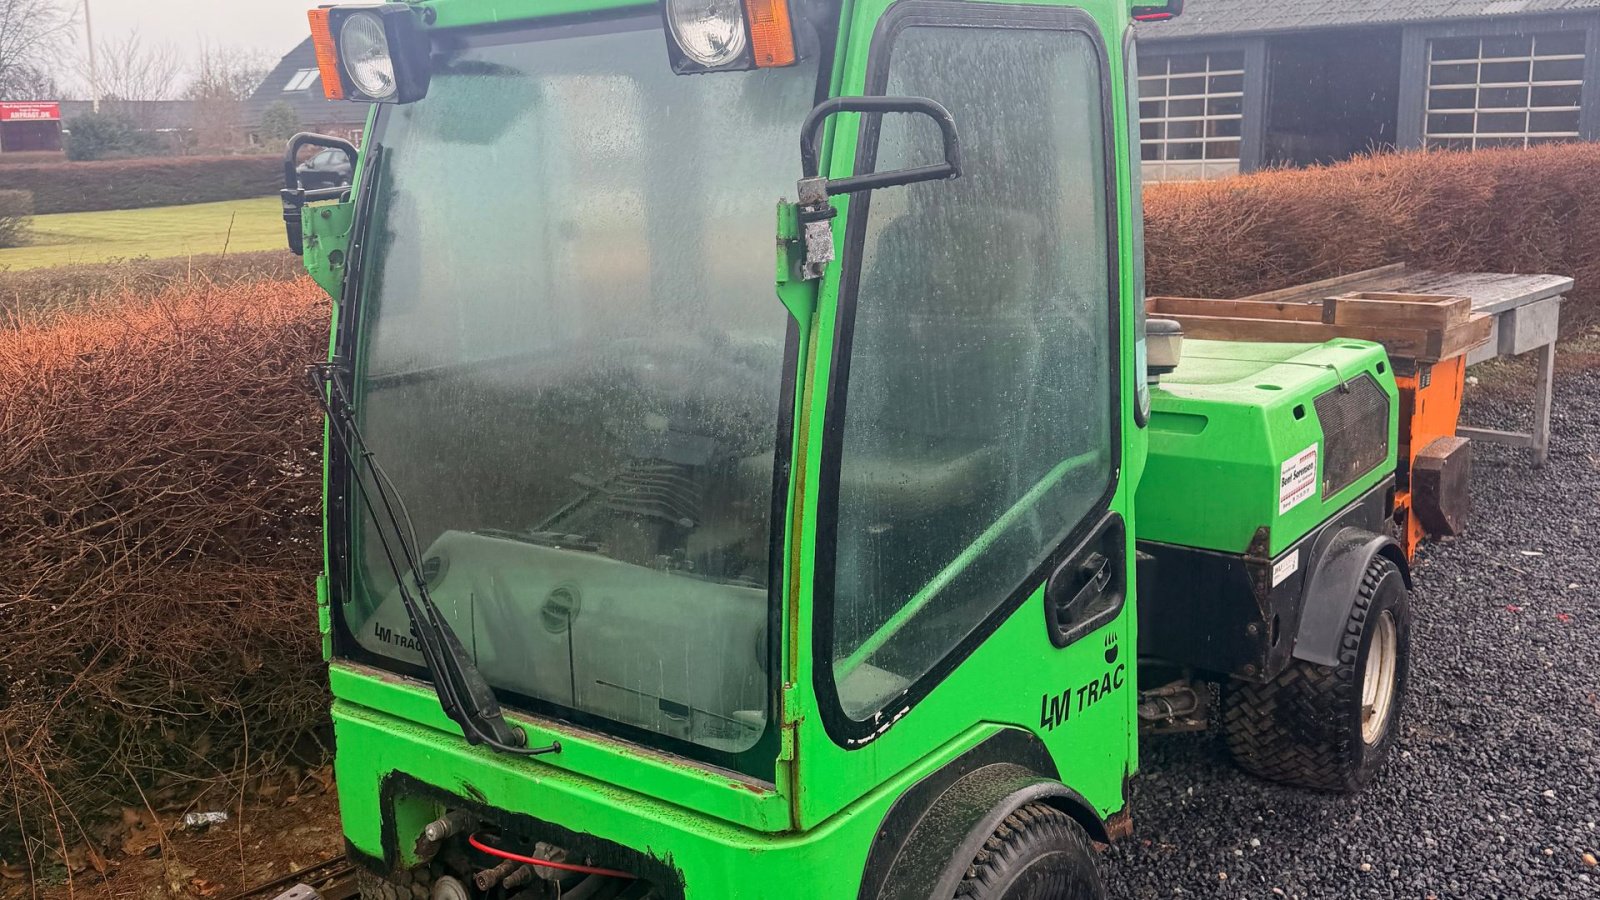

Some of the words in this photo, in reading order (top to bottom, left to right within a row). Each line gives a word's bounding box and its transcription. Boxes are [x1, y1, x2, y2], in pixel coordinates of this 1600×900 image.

[375, 622, 391, 643] LM
[394, 634, 421, 651] TRAC
[1040, 688, 1071, 732] LM
[1077, 663, 1125, 712] TRAC
